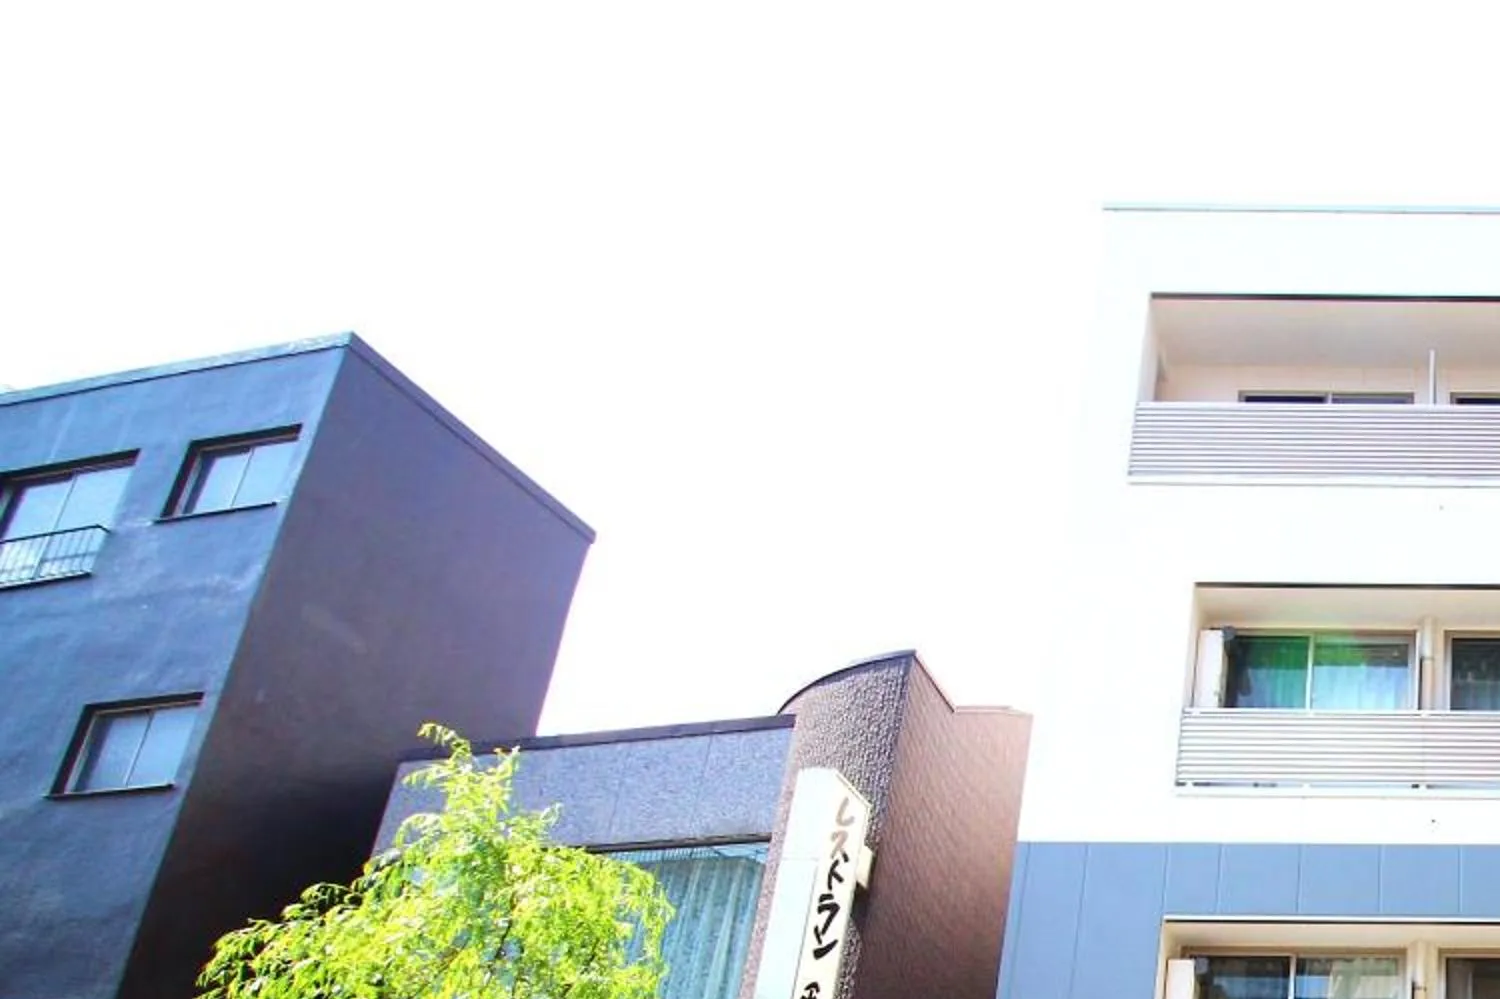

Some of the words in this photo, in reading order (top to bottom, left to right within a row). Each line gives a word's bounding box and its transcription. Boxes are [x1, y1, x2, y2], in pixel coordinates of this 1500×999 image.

[813, 797, 855, 960] レストラン
